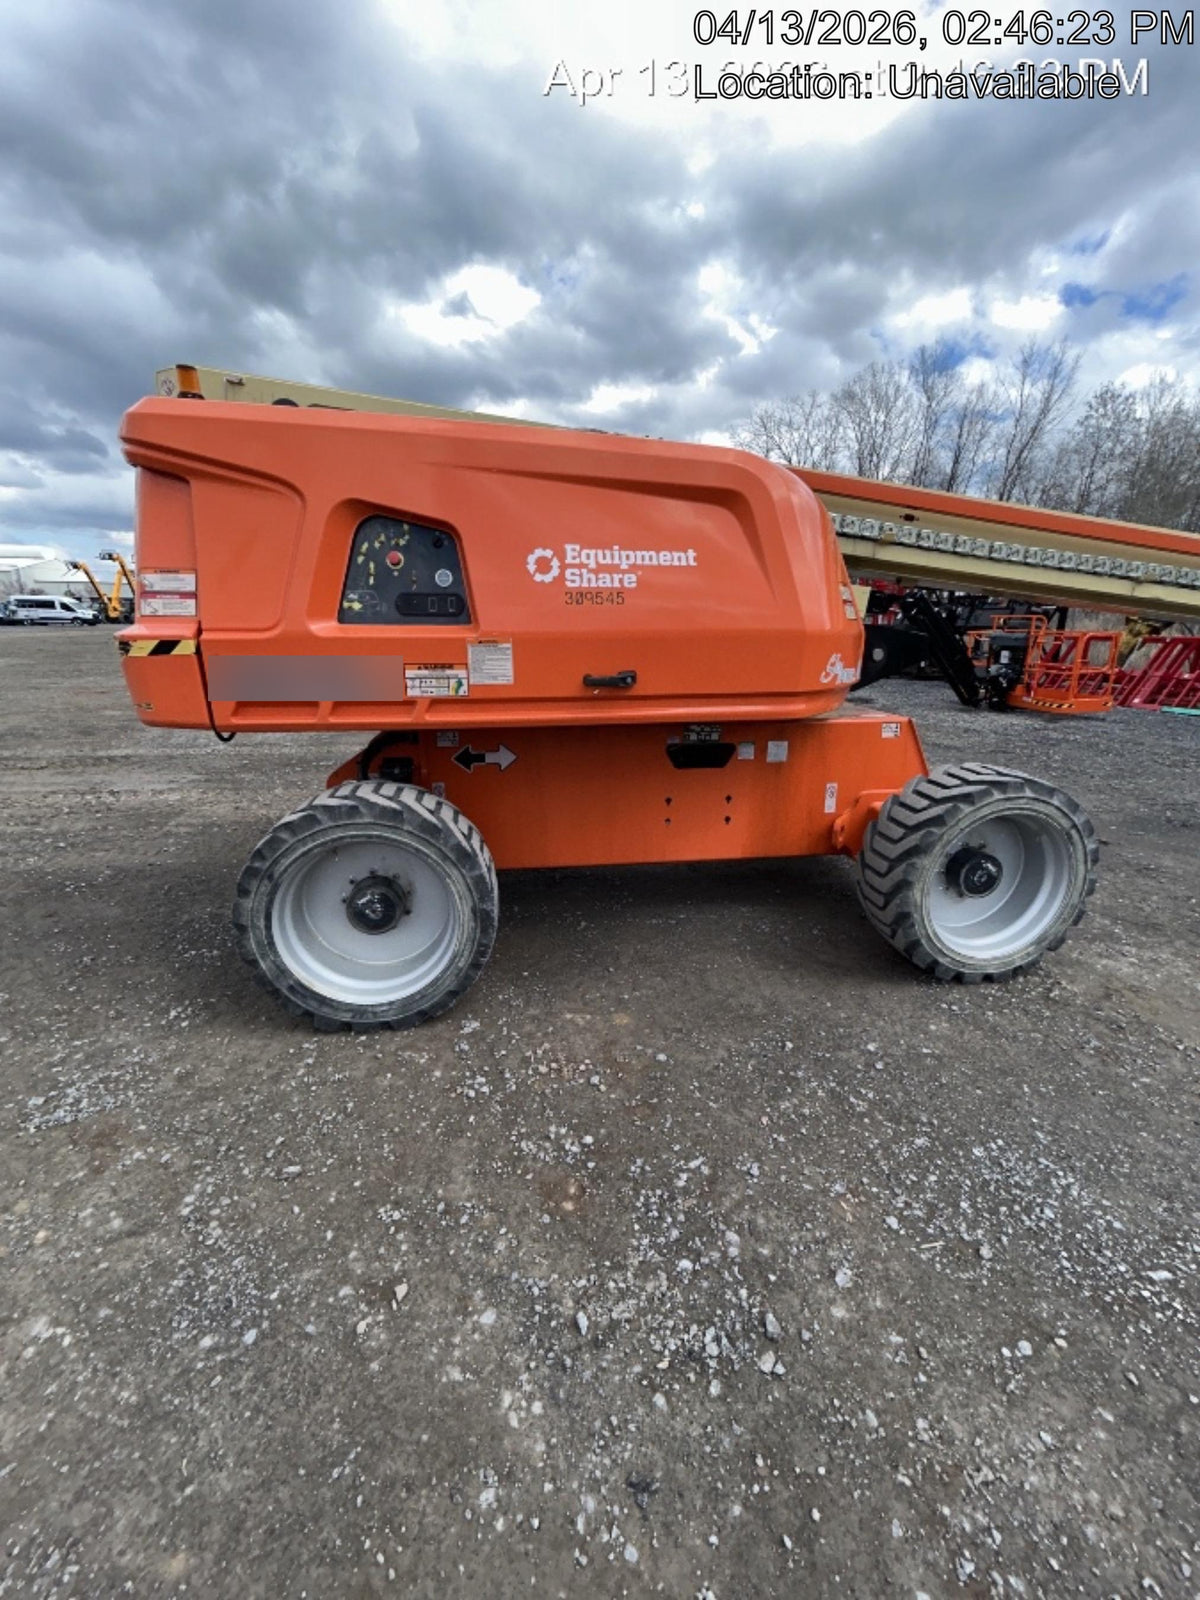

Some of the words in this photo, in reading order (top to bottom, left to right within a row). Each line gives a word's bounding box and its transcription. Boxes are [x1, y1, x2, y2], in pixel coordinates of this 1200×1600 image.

[563, 543, 698, 570] Equipment
[563, 568, 638, 589] Share
[564, 591, 626, 606] 309545
